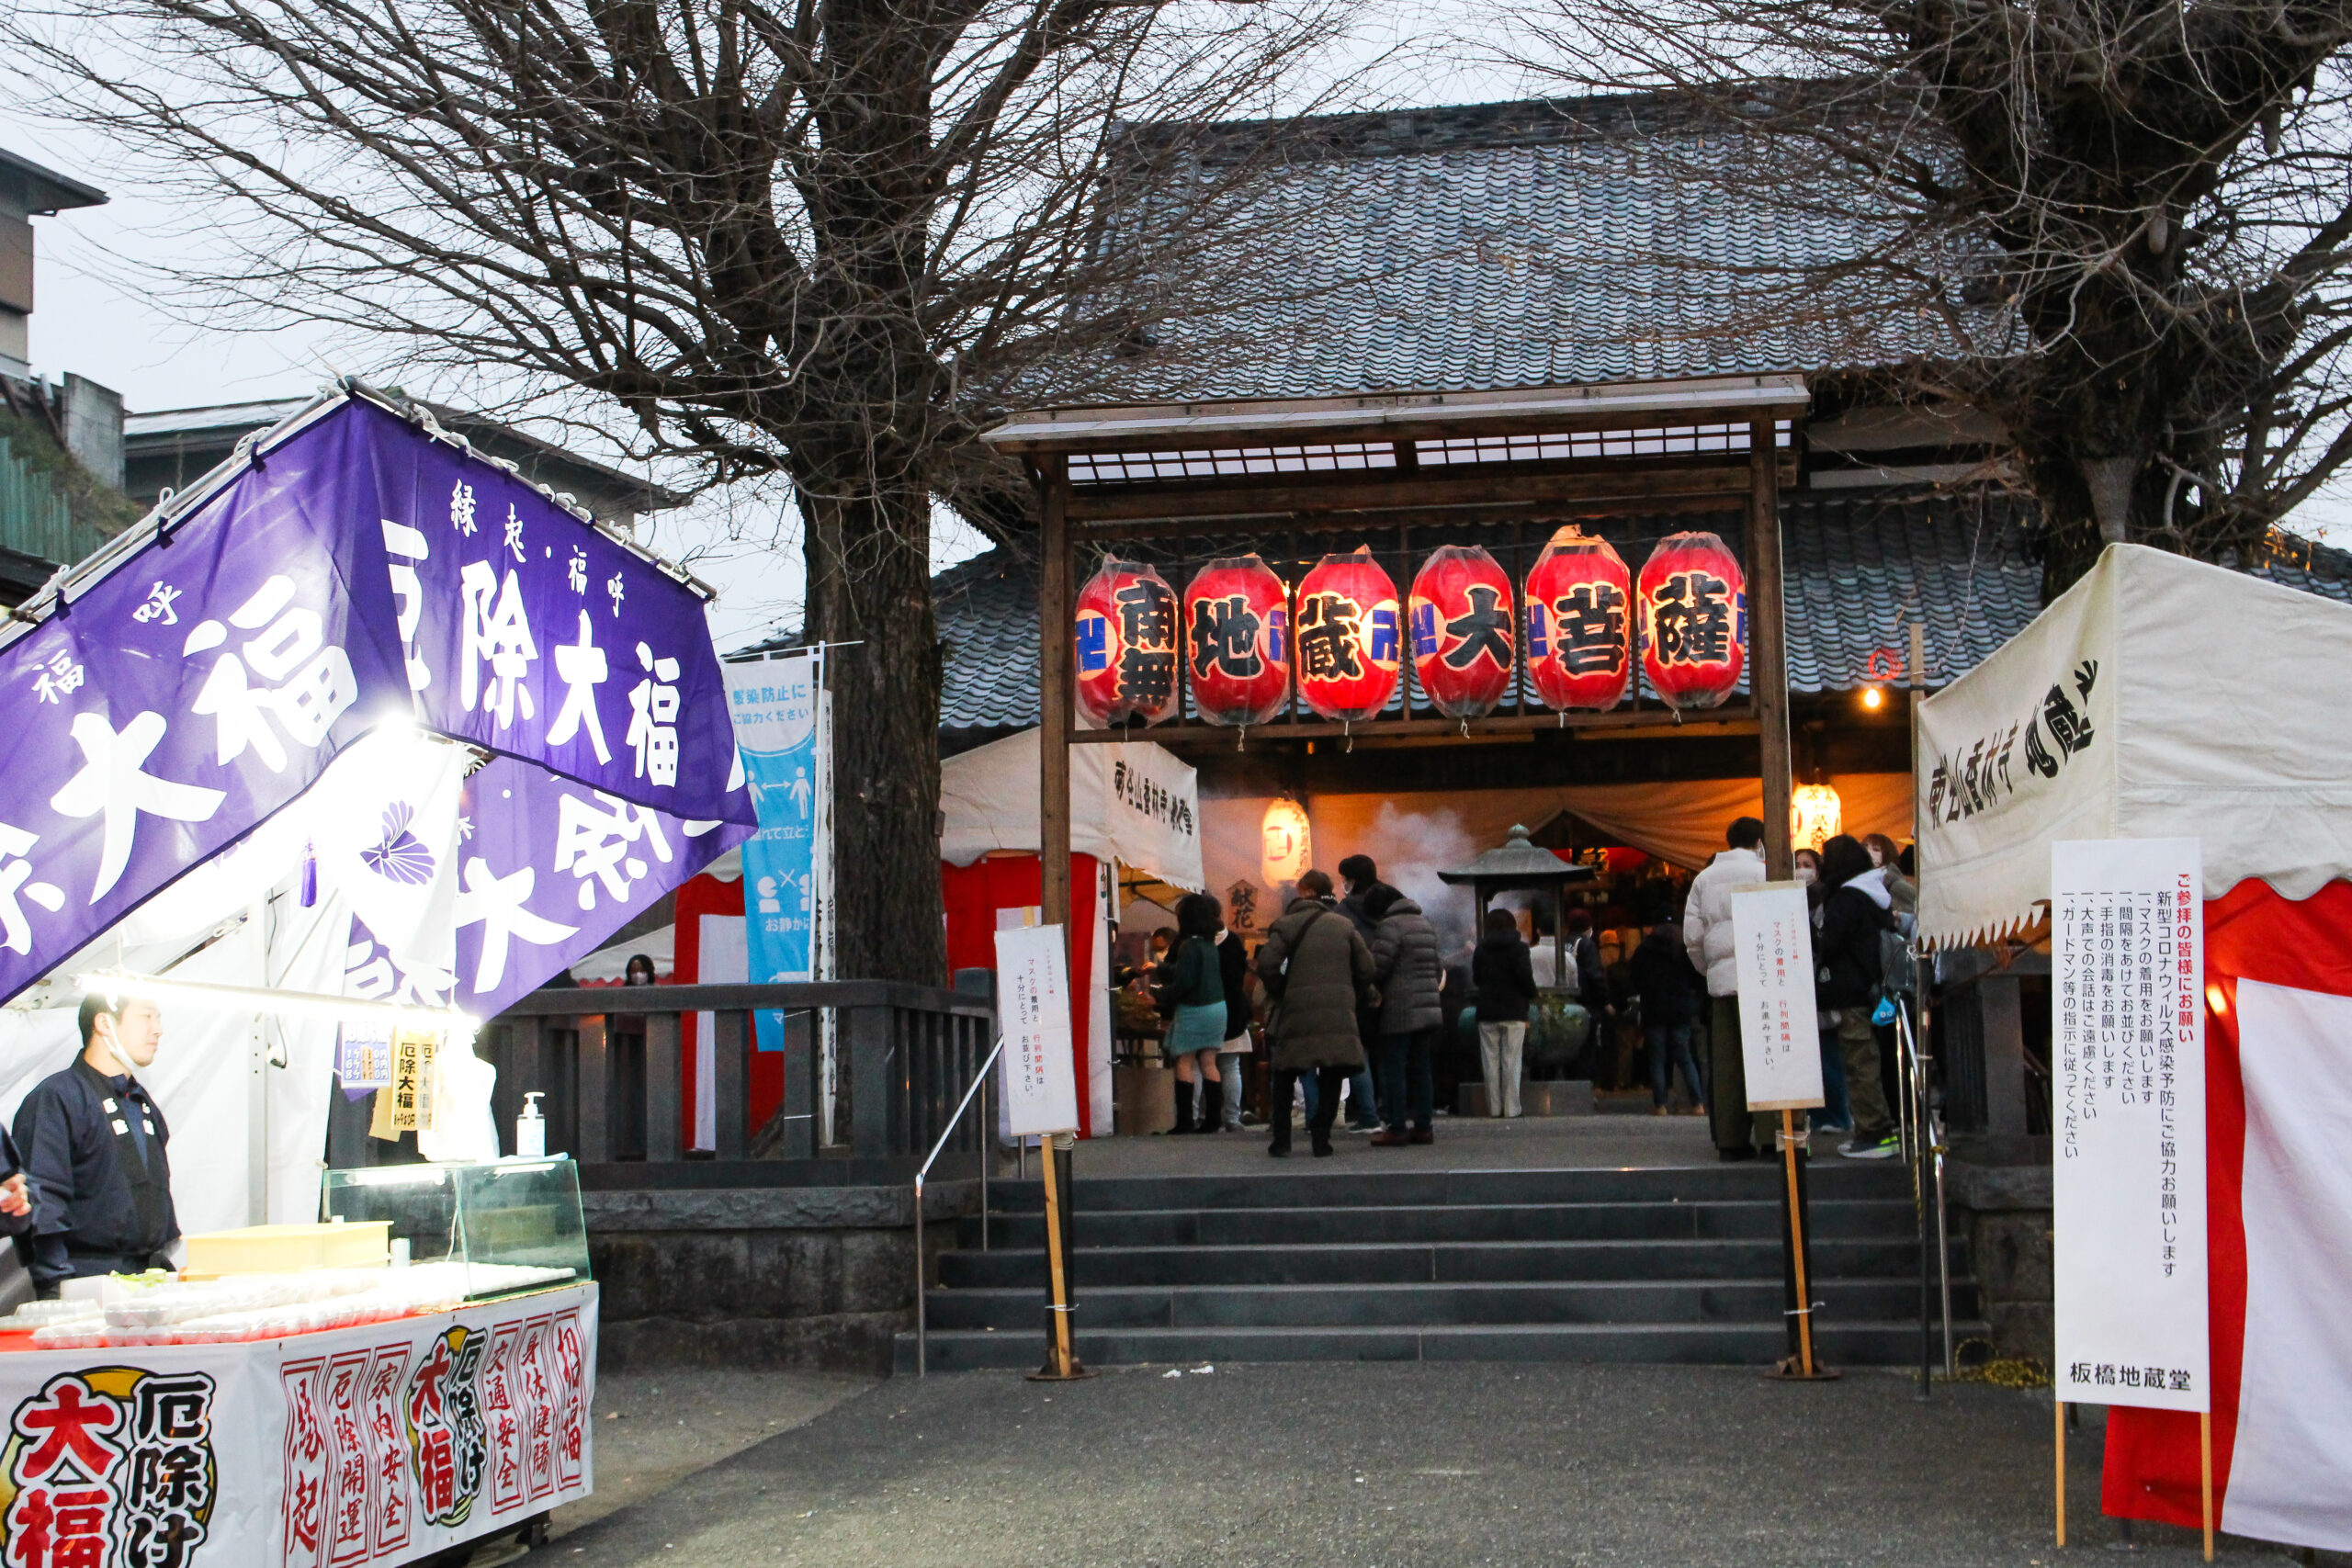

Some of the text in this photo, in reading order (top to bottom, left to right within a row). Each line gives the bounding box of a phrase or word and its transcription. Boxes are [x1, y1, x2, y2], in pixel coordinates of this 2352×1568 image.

[733, 684, 807, 705] 感染防止に
[1115, 577, 1179, 704] 南無
[1193, 596, 1264, 679] 地
[1297, 591, 1363, 681] 蔵
[1443, 583, 1512, 671] 大
[1553, 581, 1628, 682] 菩
[733, 708, 808, 725] ご協力ください
[2062, 892, 2079, 1159] 一、ガードマン等の指示に従ってください
[2081, 892, 2098, 1120] 一、大声での会話はご遠慮ください
[2100, 892, 2116, 1089] 一、手指の消毒をお願いします
[2119, 891, 2136, 1105] 一、間隔をあけてお並びください
[2137, 892, 2154, 1104] 一、マスクの着用をお願いします
[2177, 874, 2194, 1043] ご参拝の皆様にお願い
[397, 1042, 416, 1109] 厄除大福
[2157, 891, 2177, 1277] 新型コロナウィルス感染予防にご協力お願いします
[329, 1370, 366, 1544] 厄除開運
[368, 1362, 404, 1529] 家内安全
[413, 1342, 454, 1515] 大福
[448, 1335, 485, 1493] 厄除け
[485, 1340, 517, 1489] 交通安全
[557, 1325, 582, 1461] 招福
[2070, 1361, 2192, 1392] 板橋地蔵堂
[14, 1383, 116, 1568] 大福
[128, 1380, 209, 1568] 厄除け
